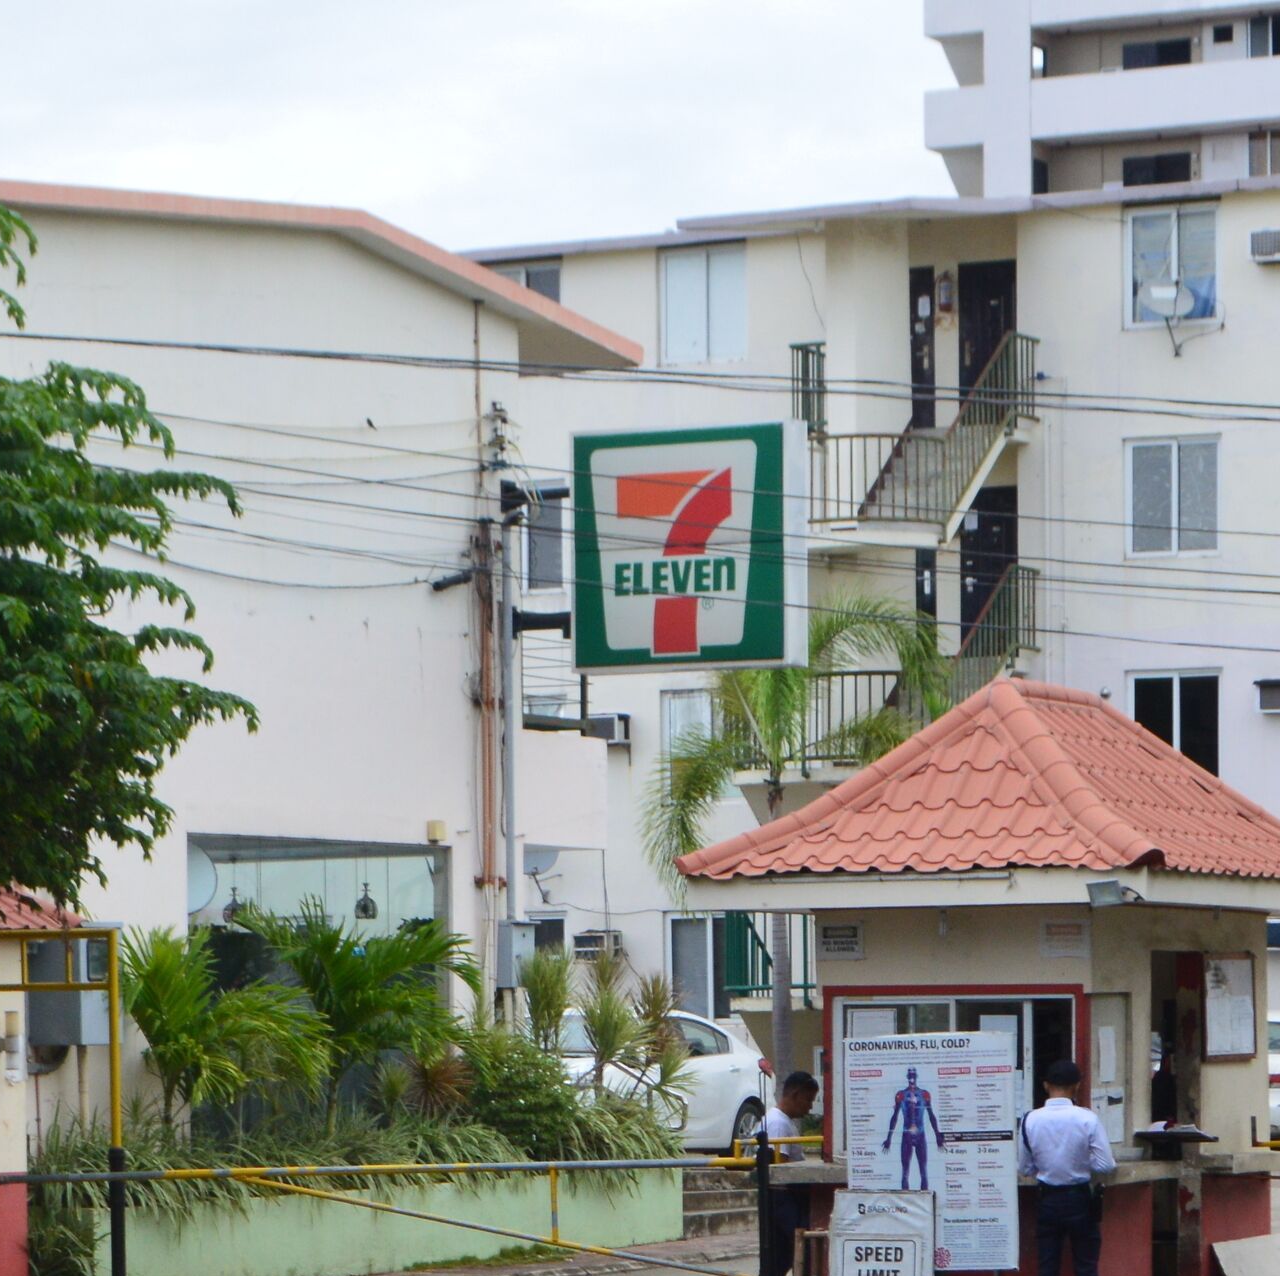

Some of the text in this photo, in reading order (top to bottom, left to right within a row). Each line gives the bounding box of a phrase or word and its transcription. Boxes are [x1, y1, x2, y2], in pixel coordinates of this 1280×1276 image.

[616, 467, 733, 655] 7
[849, 1038, 970, 1051] CORONAVIRUS, FLU, COLD?
[855, 1246, 903, 1262] SPEED
